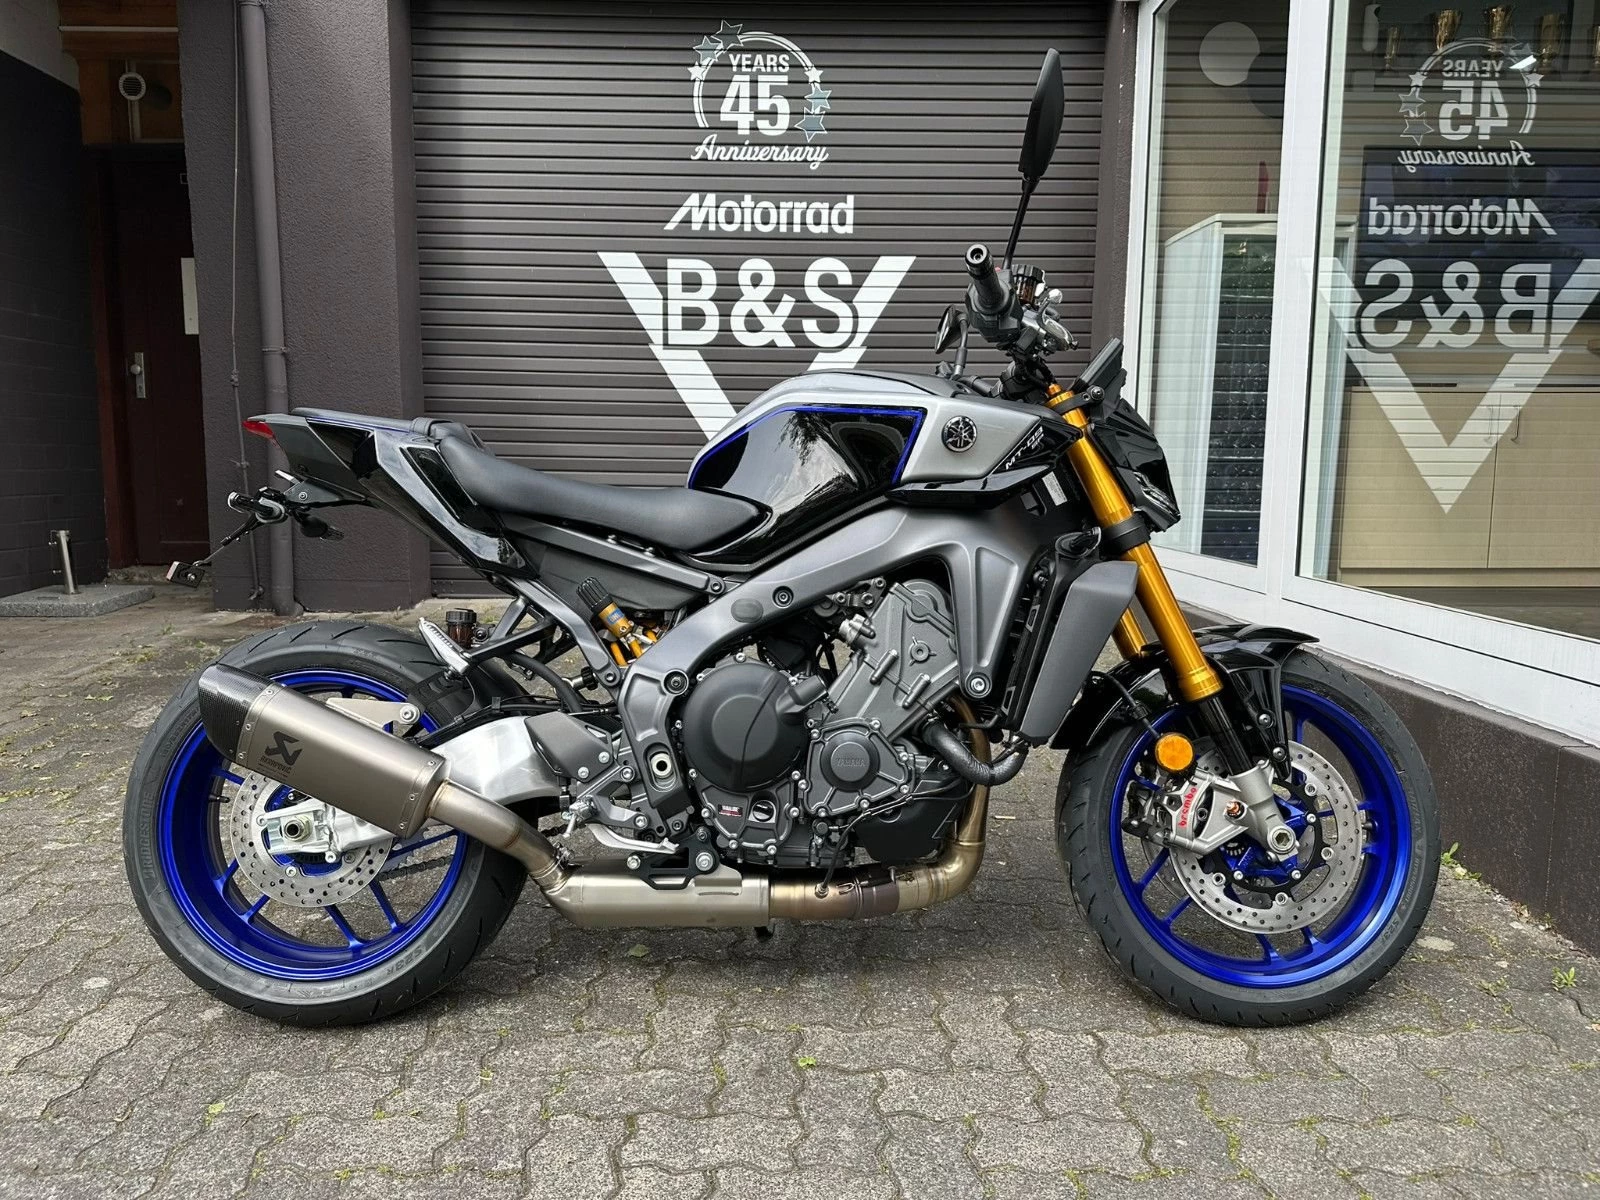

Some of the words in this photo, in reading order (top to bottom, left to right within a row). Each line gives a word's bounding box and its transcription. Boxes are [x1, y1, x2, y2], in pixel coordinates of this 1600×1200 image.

[729, 53, 790, 73] YEARS
[720, 75, 791, 135] 45
[690, 133, 830, 170] Anniversary
[663, 192, 855, 235] Motorrad
[666, 256, 857, 349] B&S
[1005, 426, 1044, 470] MT-09
